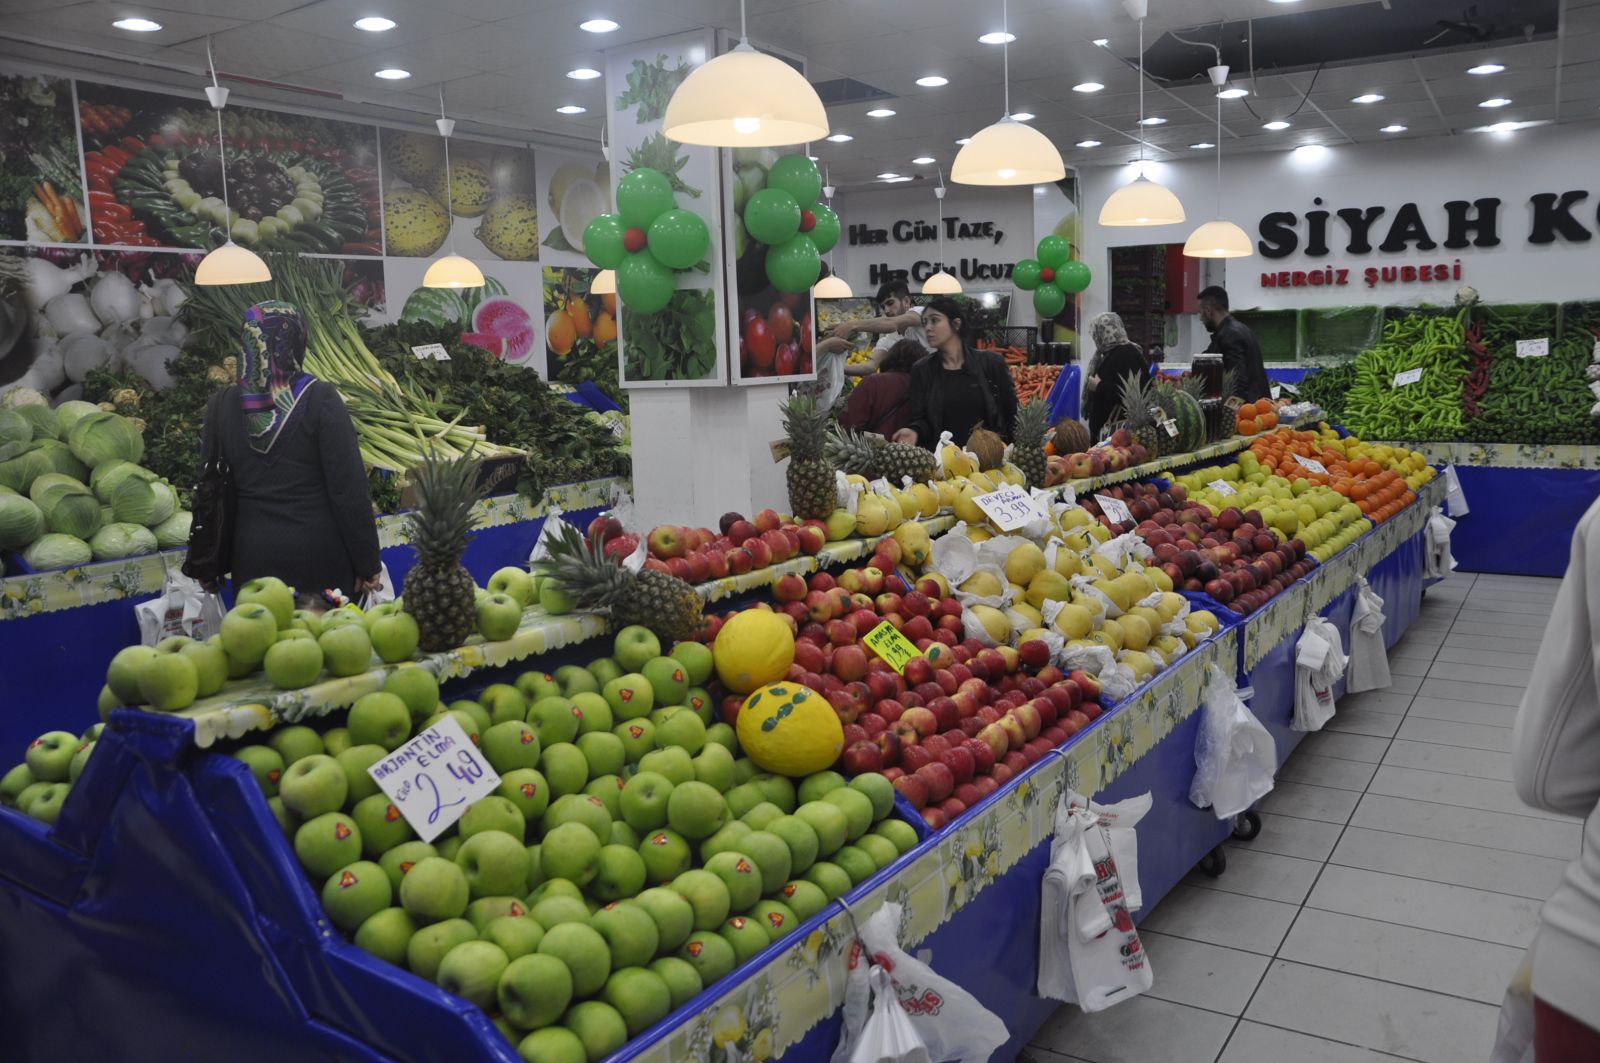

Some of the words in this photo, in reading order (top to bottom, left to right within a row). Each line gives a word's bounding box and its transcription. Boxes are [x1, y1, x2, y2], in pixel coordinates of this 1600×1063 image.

[1258, 196, 1501, 259] SİYAH
[1527, 189, 1600, 244] K
[1260, 264, 1349, 288] NERGİZ
[1364, 259, 1461, 288] ŞUBESİ
[373, 727, 442, 780] ARJANTİN
[416, 735, 457, 768] ELMA
